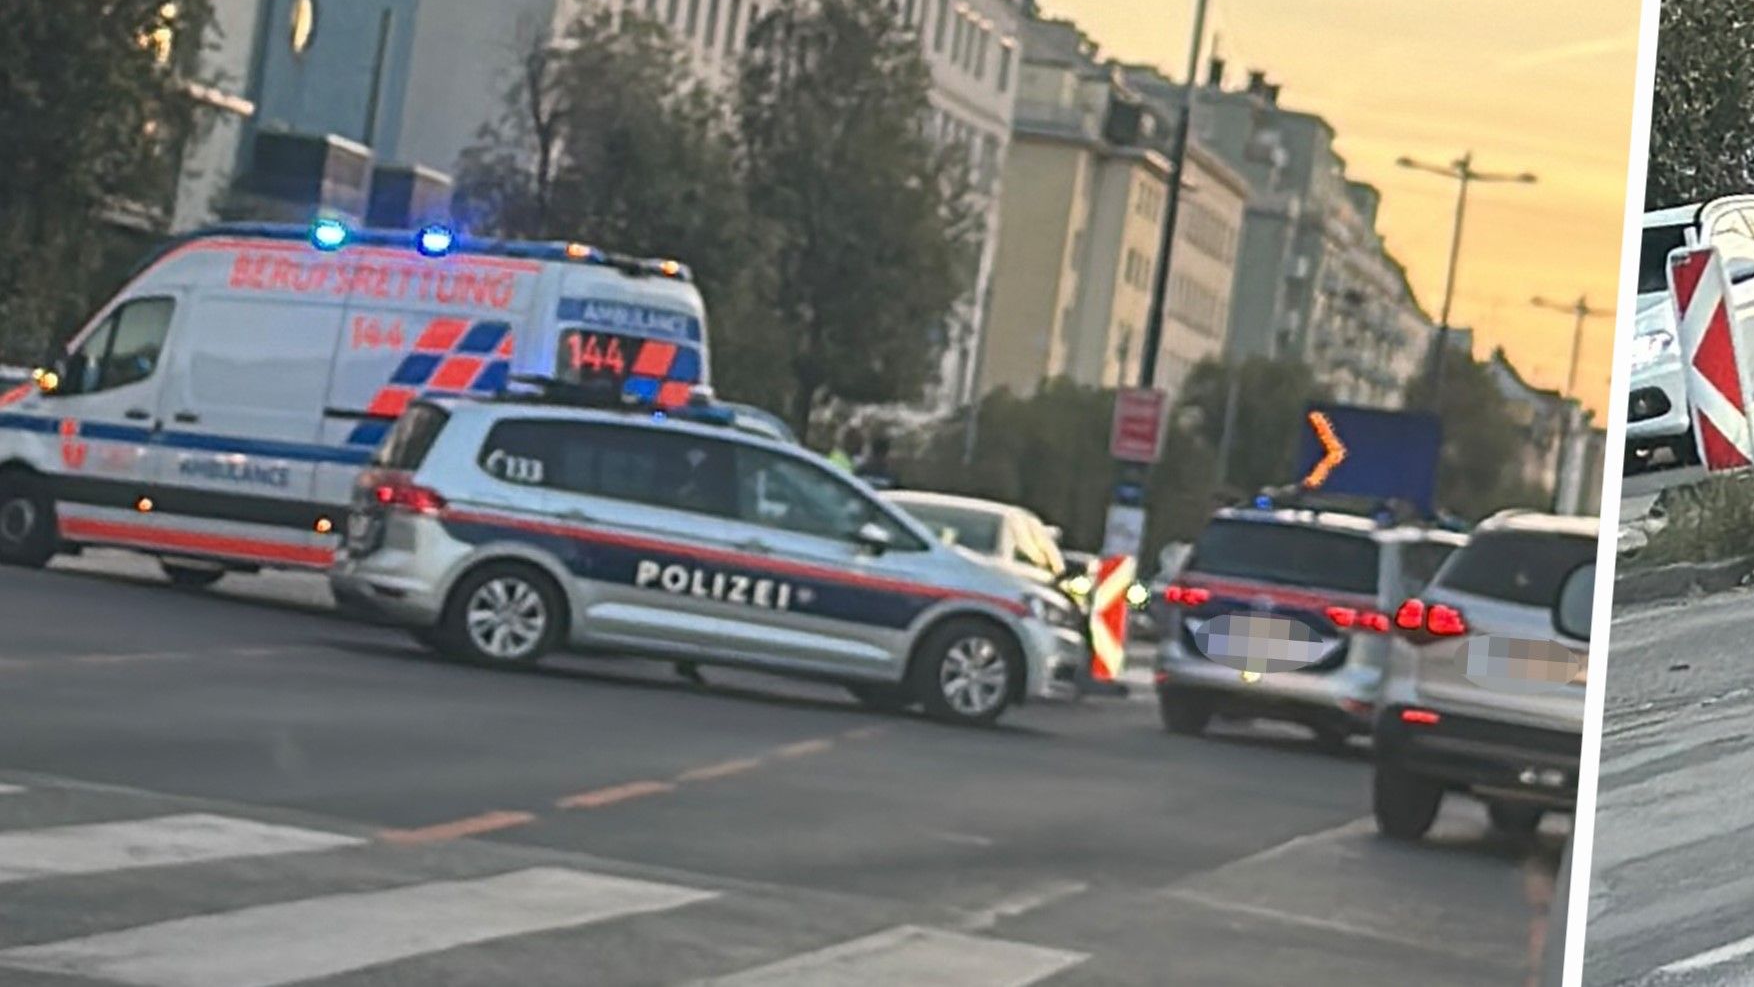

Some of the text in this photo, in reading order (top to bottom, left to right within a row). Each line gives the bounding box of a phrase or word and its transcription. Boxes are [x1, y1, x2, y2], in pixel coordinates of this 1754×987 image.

[228, 254, 515, 310] BERUFSRETTUNG
[353, 315, 406, 350] 144
[567, 331, 625, 375] 144
[505, 457, 544, 483] 133
[635, 559, 793, 611] POLIZEI
